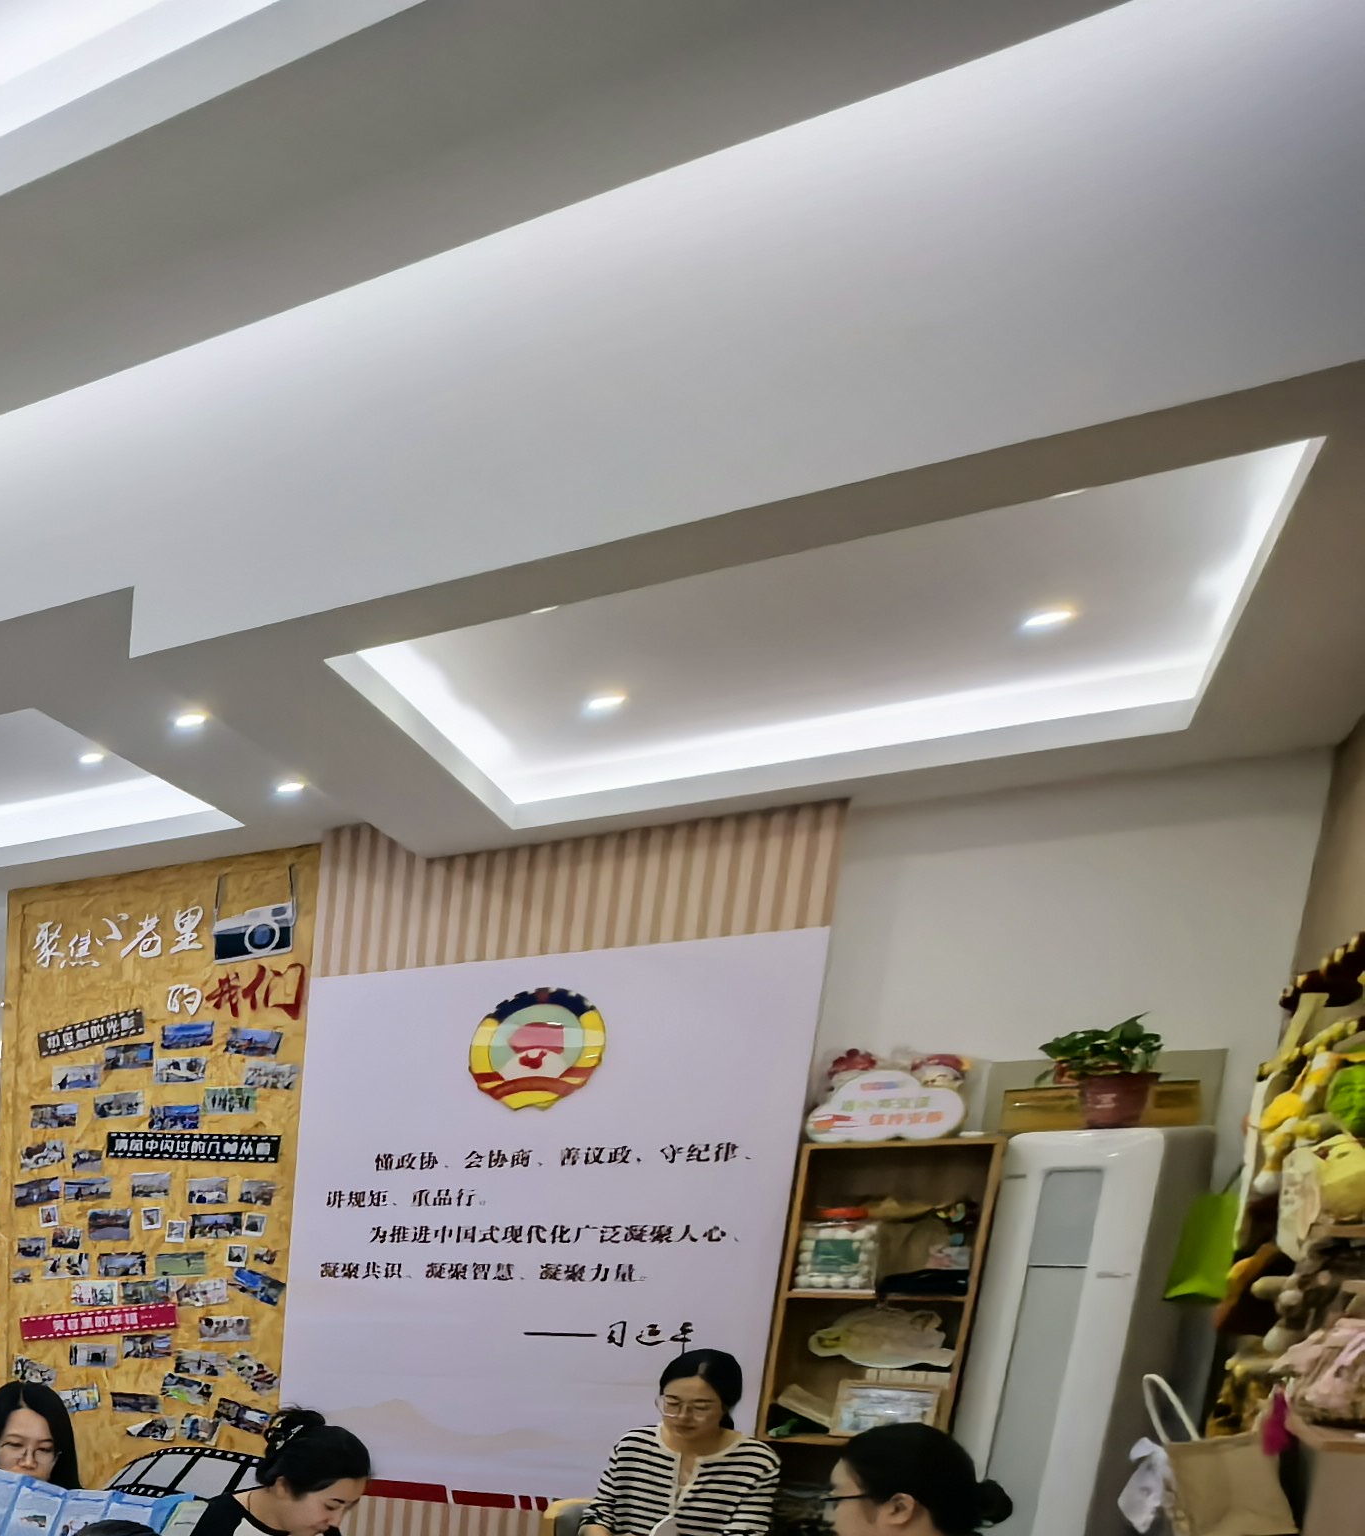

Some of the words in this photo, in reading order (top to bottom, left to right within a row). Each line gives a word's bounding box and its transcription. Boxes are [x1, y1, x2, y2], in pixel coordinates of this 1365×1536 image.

[370, 1224, 739, 1244] 为推进中国式现代化广泛凝聚人心、
